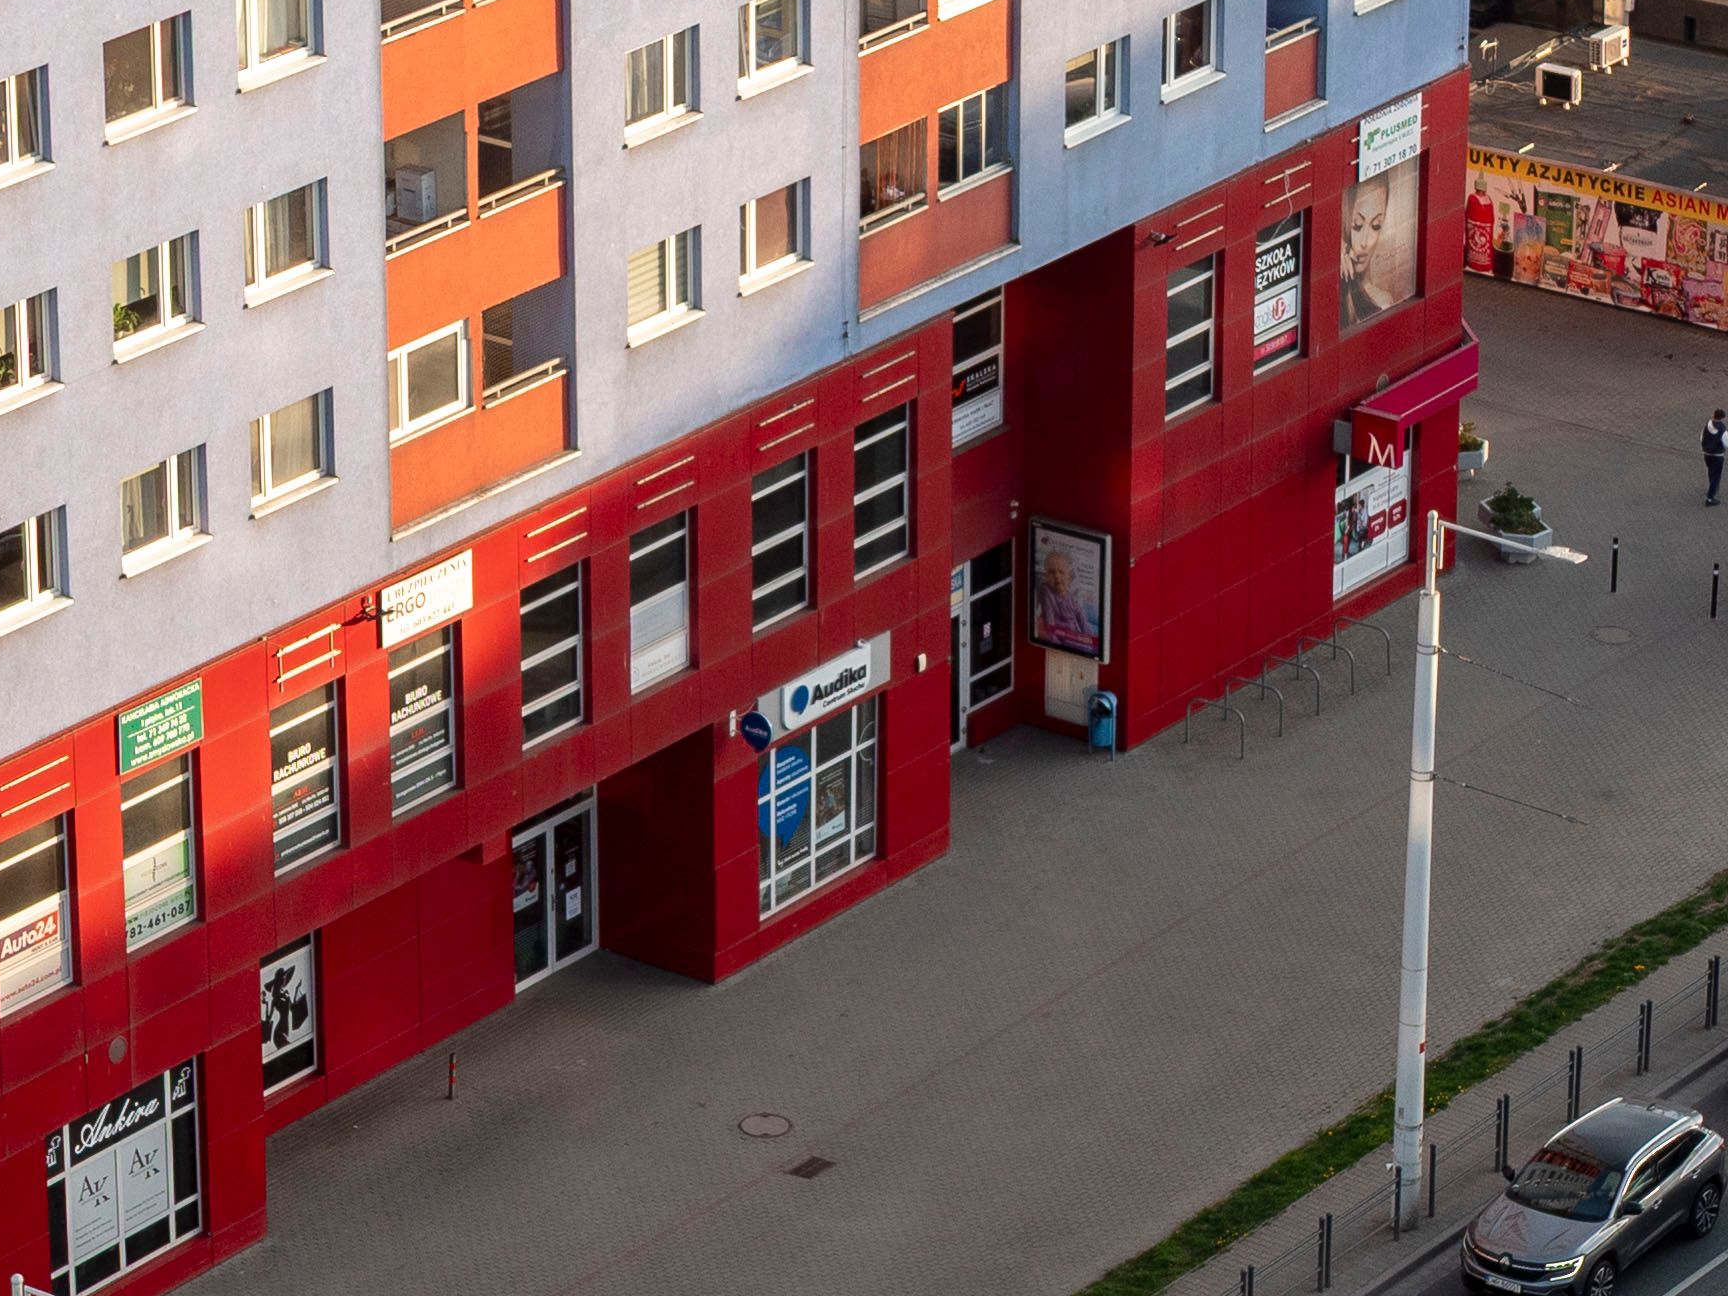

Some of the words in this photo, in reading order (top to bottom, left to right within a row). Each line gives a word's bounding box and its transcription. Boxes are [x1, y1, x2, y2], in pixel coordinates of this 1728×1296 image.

[1380, 114, 1418, 141] PLUSMED
[1468, 148, 1522, 174] UKTY
[1527, 162, 1646, 201] AZJATYCKIE
[1651, 190, 1711, 216] ASIAN
[1255, 244, 1292, 273] SZKOŁA
[1255, 256, 1296, 291] ĘZYKÓW
[386, 592, 426, 623] ERGO
[404, 685, 428, 705] BIURO
[812, 664, 867, 705] Audika
[822, 691, 845, 708] Centrum
[121, 702, 159, 724] KANCELARIA
[160, 683, 200, 707] ADWOKACKA
[391, 690, 443, 724] RACHUNKOWE
[273, 747, 326, 781] RACHUNKOWE
[287, 742, 312, 762] BIURO
[0, 915, 57, 959] Auto24
[74, 1097, 159, 1153] Ankira
